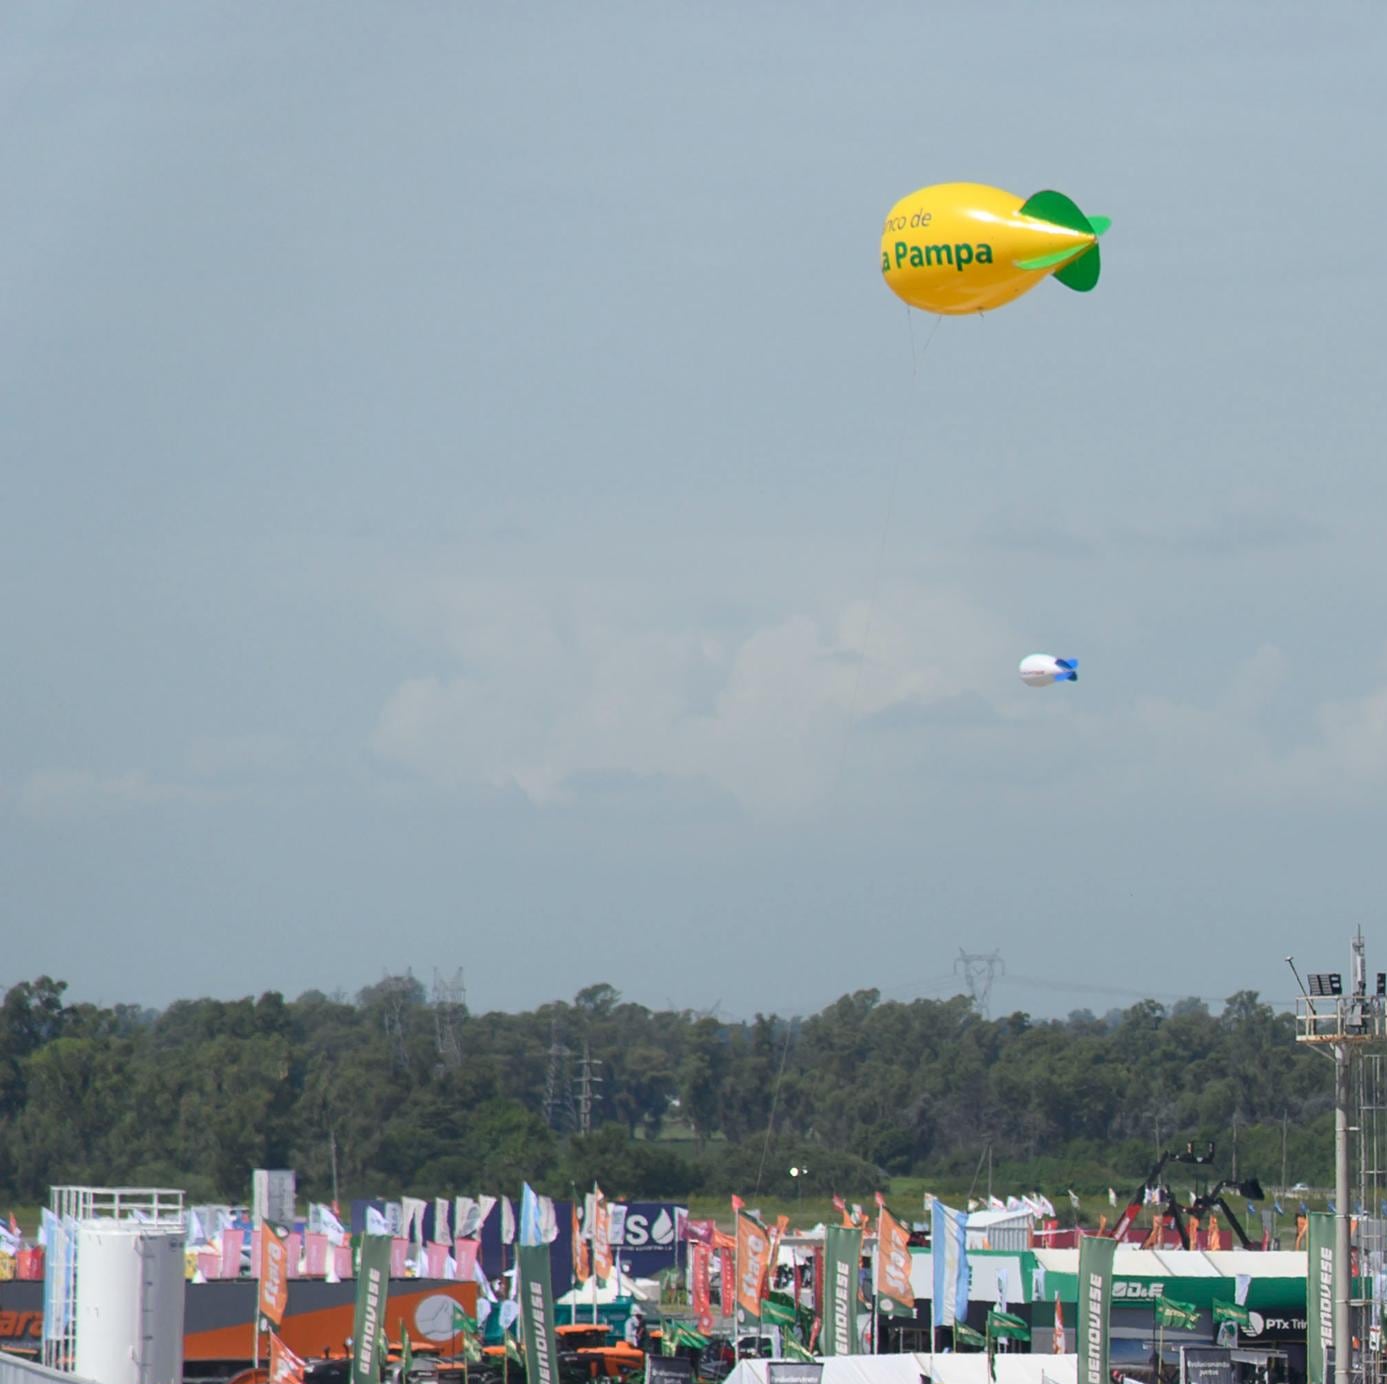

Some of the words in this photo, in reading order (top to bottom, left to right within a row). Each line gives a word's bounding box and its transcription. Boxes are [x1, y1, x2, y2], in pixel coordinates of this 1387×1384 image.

[910, 208, 932, 229] de
[894, 240, 994, 272] Pampa
[359, 1267, 381, 1376] GENOVESE
[834, 1260, 850, 1356] ENOVESE
[1085, 1272, 1103, 1384] GENOVESE
[1265, 1318, 1290, 1330] PTx
